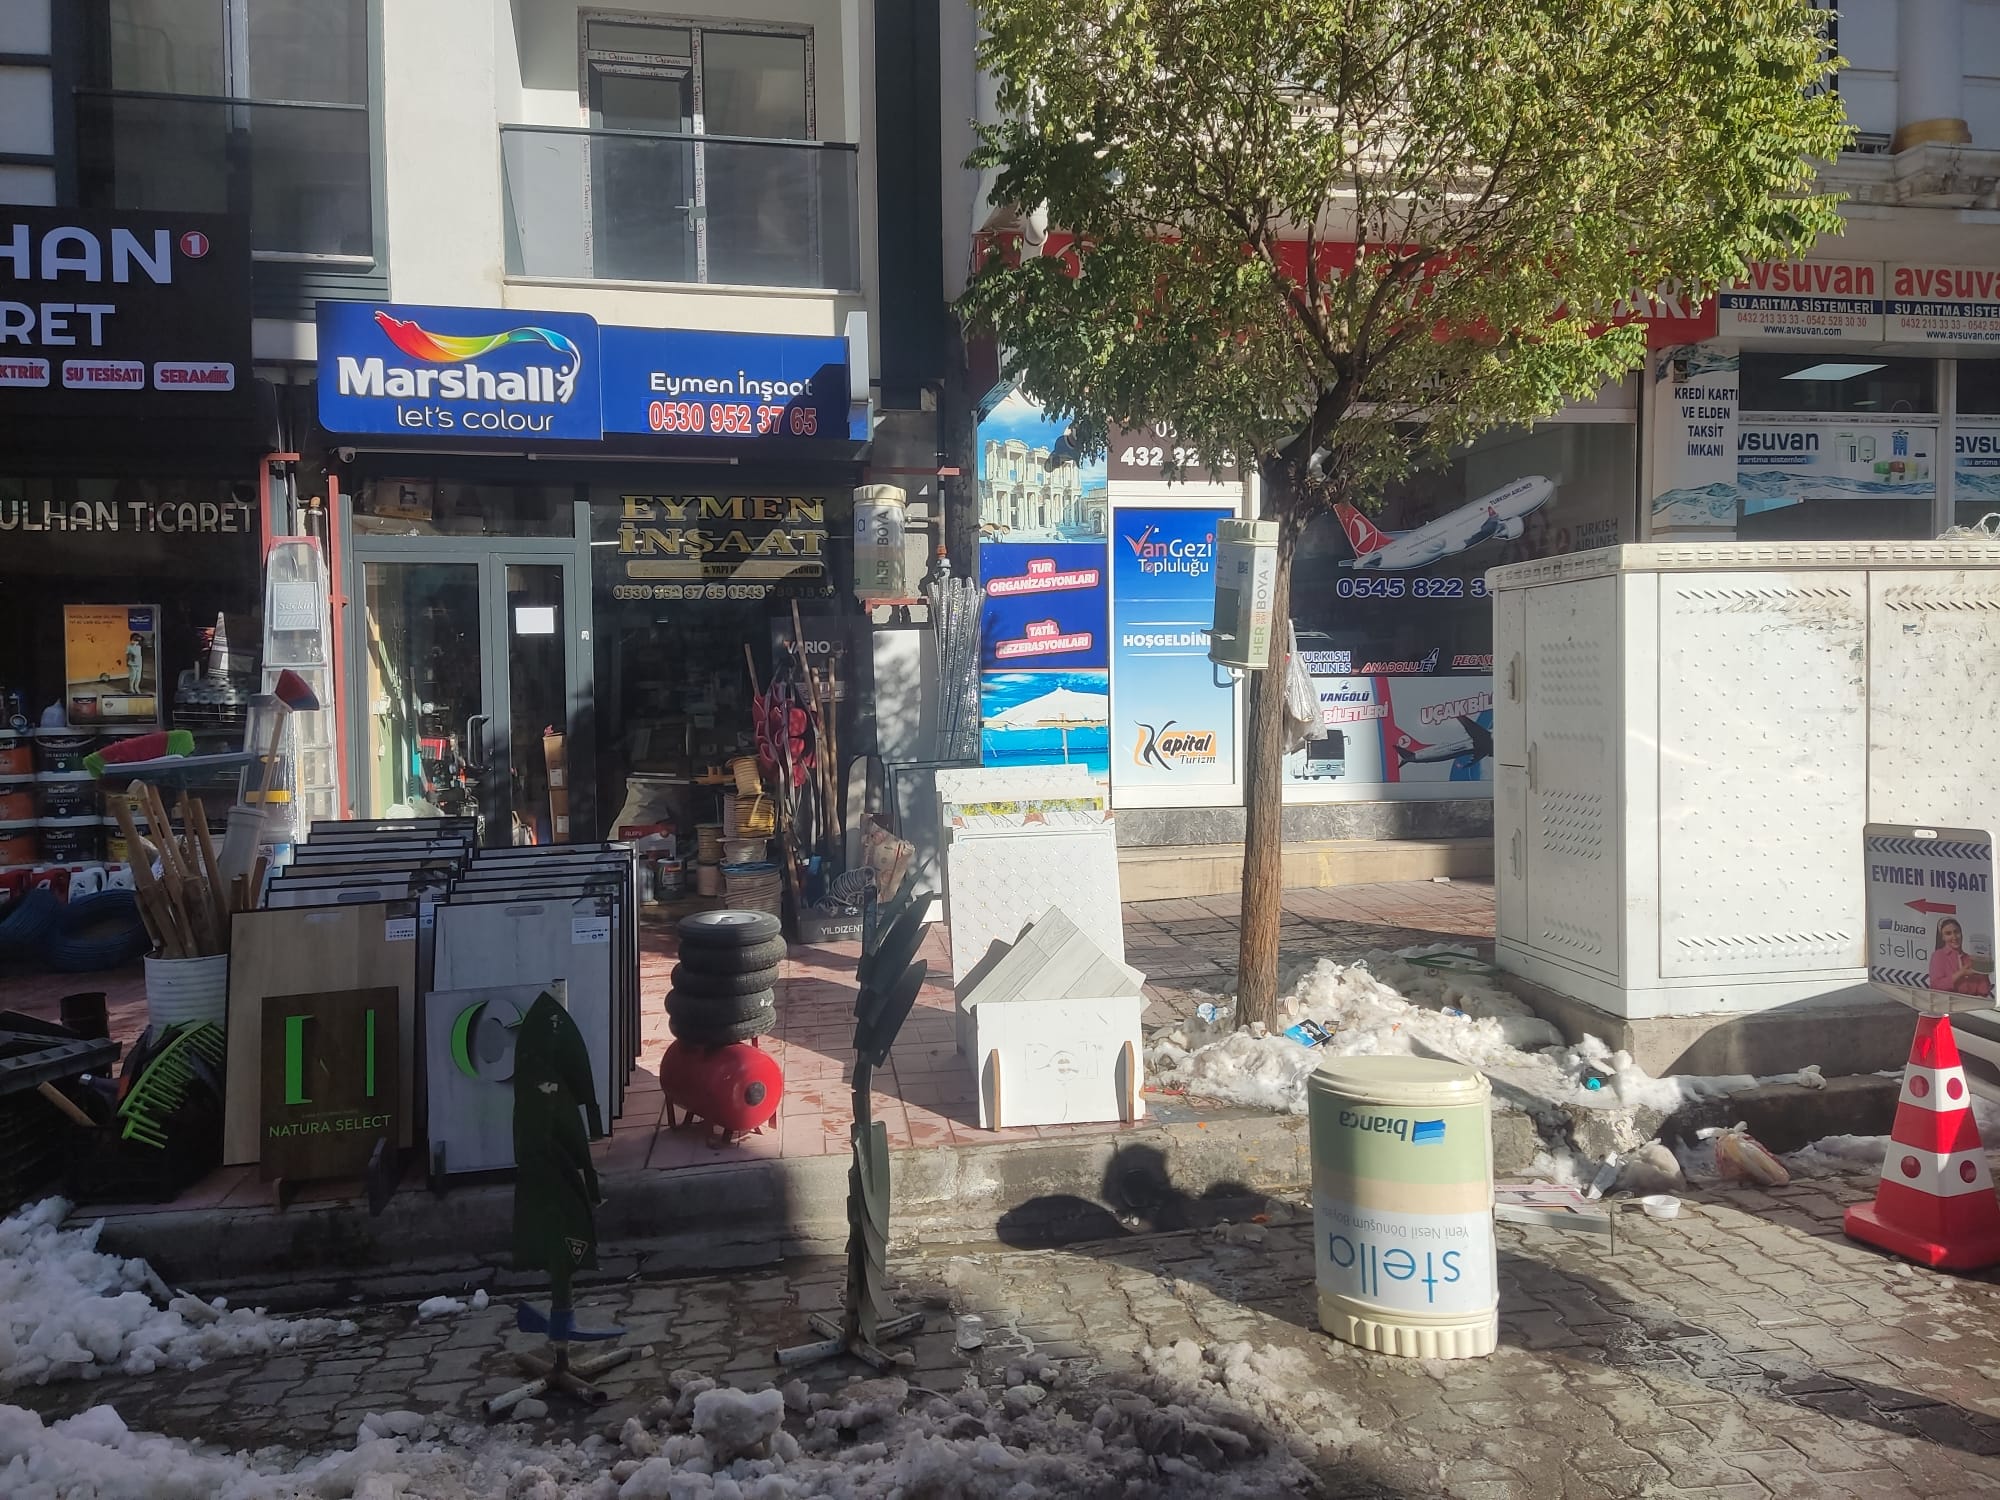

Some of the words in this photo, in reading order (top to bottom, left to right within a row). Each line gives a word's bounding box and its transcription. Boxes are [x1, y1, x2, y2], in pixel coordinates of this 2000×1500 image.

[1894, 268, 2000, 299] avsuv
[1731, 298, 1747, 309] SU
[1751, 299, 1799, 311] ARITMA
[1801, 299, 1874, 314] SİSTEMLERİ
[1895, 304, 1911, 315] SU
[1914, 304, 1961, 317] ARITMA
[1738, 313, 1757, 323] 0432
[1760, 314, 1775, 324] 213
[1777, 315, 1787, 324] 33
[1789, 315, 1799, 325] 33
[1806, 316, 1826, 325] 0542
[1828, 316, 1843, 326] 528
[1845, 317, 1855, 327] 30
[1857, 318, 1867, 327] 30
[1901, 318, 1920, 329] 0432
[1922, 318, 1937, 329] 213
[1939, 319, 1949, 329] 33
[1951, 320, 1961, 330] 33
[1968, 320, 1987, 330] 0542
[1989, 321, 2000, 331] 52
[1764, 325, 1842, 336] www.avsuvan.com
[66, 367, 84, 382] SU
[87, 364, 143, 383] TESİSATI
[160, 366, 230, 385] SERAMİK
[337, 356, 555, 403] Marshall
[650, 372, 733, 396] Eymen
[738, 370, 813, 401] İnşaat
[1674, 385, 1705, 400] KREDİ
[1708, 388, 1738, 401] KARTI
[397, 405, 454, 428] let's
[462, 408, 554, 431] colour
[649, 401, 704, 432] 0530
[710, 404, 751, 434] 952
[757, 406, 784, 434] 37
[790, 407, 817, 435] 65
[1682, 406, 1695, 418] VE
[1698, 407, 1730, 419] ELDEN
[1688, 423, 1724, 438] TAKSİT
[1688, 440, 1724, 456] İMKANI
[127, 502, 256, 533] TİCARET
[620, 495, 825, 522] EYMEN
[617, 523, 830, 560] İNŞAAT
[1031, 563, 1053, 574] TUR
[1138, 558, 1209, 577] Topluluğu
[613, 585, 652, 599] 0530
[1256, 569, 1269, 610] BOYA
[1336, 578, 1405, 598] 0545
[1412, 578, 1463, 598] 822
[1471, 578, 1494, 598] 3
[1029, 623, 1057, 637] TATİL
[1304, 663, 1352, 674] IRLINES
[1322, 701, 1389, 725] BİLETLERİ
[1135, 720, 1213, 770] Kapital
[1180, 754, 1217, 766] Turizm
[1871, 864, 1925, 887] EYMEN
[1930, 869, 1989, 893] İNŞAAT
[1894, 920, 1927, 935] bianca
[1879, 936, 1928, 962] stella
[269, 1120, 331, 1138] NATURA
[335, 1114, 393, 1131] SELECT
[1338, 1111, 1408, 1142] bianca
[1411, 1224, 1443, 1240] Nesil
[1444, 1225, 1470, 1238] Yeni
[1329, 1232, 1462, 1304] stella
